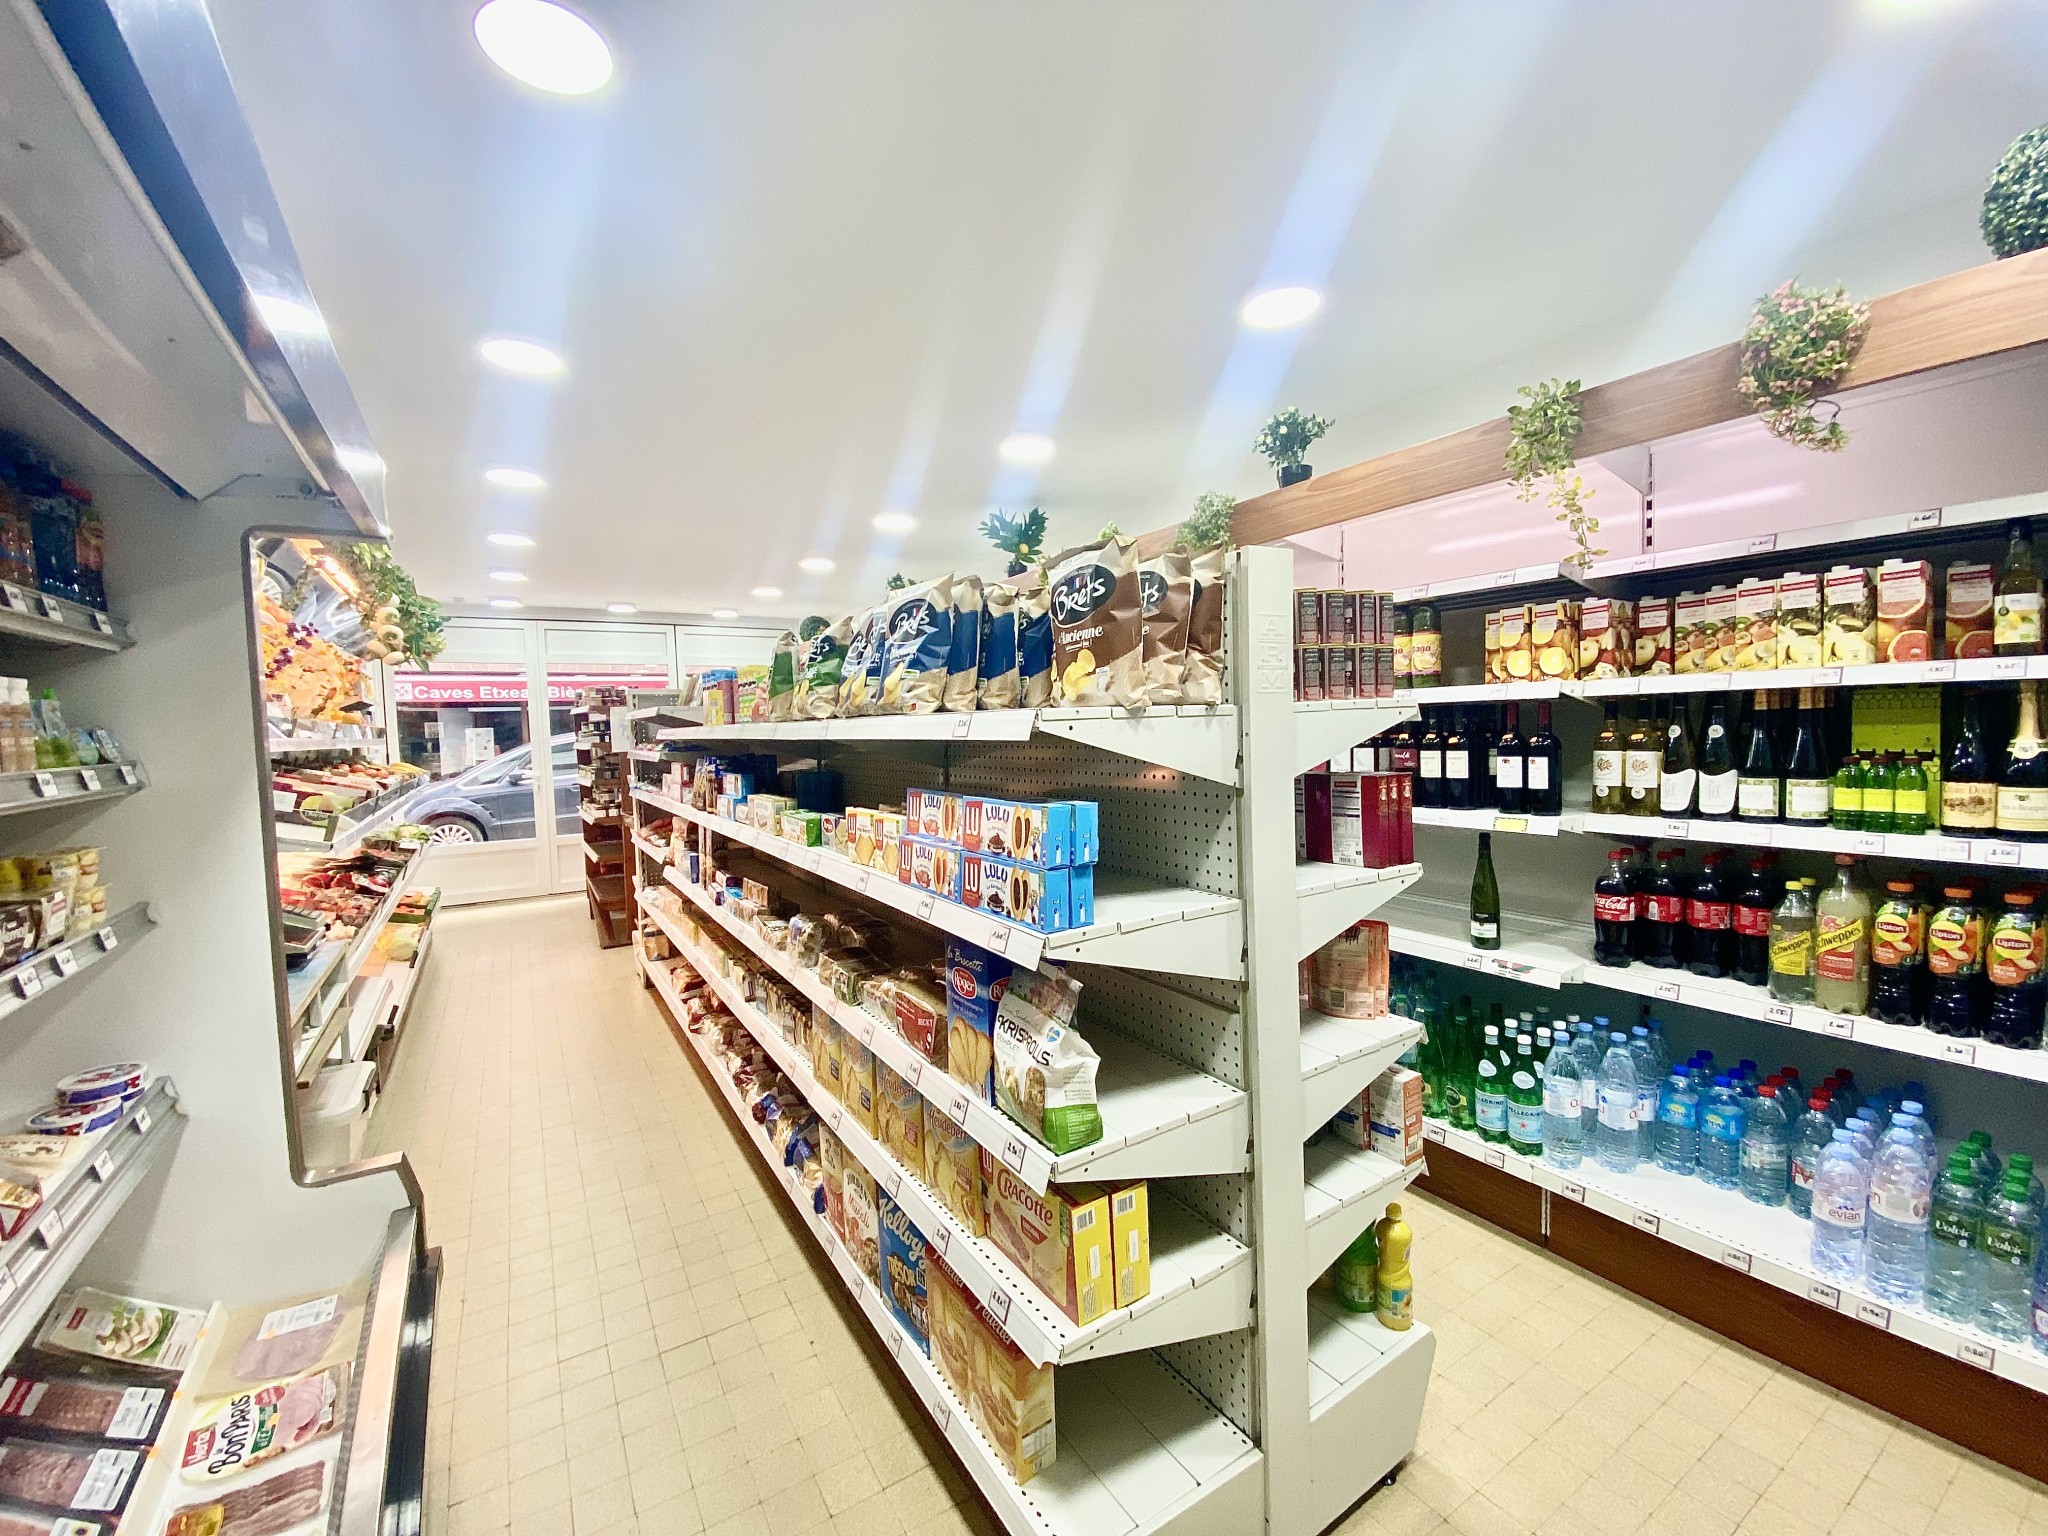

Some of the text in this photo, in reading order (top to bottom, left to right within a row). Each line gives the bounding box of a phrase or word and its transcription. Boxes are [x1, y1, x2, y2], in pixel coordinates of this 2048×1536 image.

[1052, 577, 1107, 620] Brets
[414, 685, 473, 700] Caves
[909, 796, 920, 822] LU
[924, 795, 942, 810] LULU
[965, 806, 980, 836] LU
[985, 806, 1010, 823] LULU
[901, 845, 912, 871] LU
[915, 846, 933, 862] LULU
[964, 861, 979, 893] LU
[984, 863, 1008, 882] LULU
[1878, 922, 1904, 932] Lipton
[1932, 930, 1961, 940] Lipton
[1996, 938, 2029, 949] Lipton
[954, 971, 975, 994] Roger
[997, 1014, 1051, 1067] KRISPROLLS
[1828, 1208, 1861, 1221] evian
[187, 1429, 212, 1466] Herta
